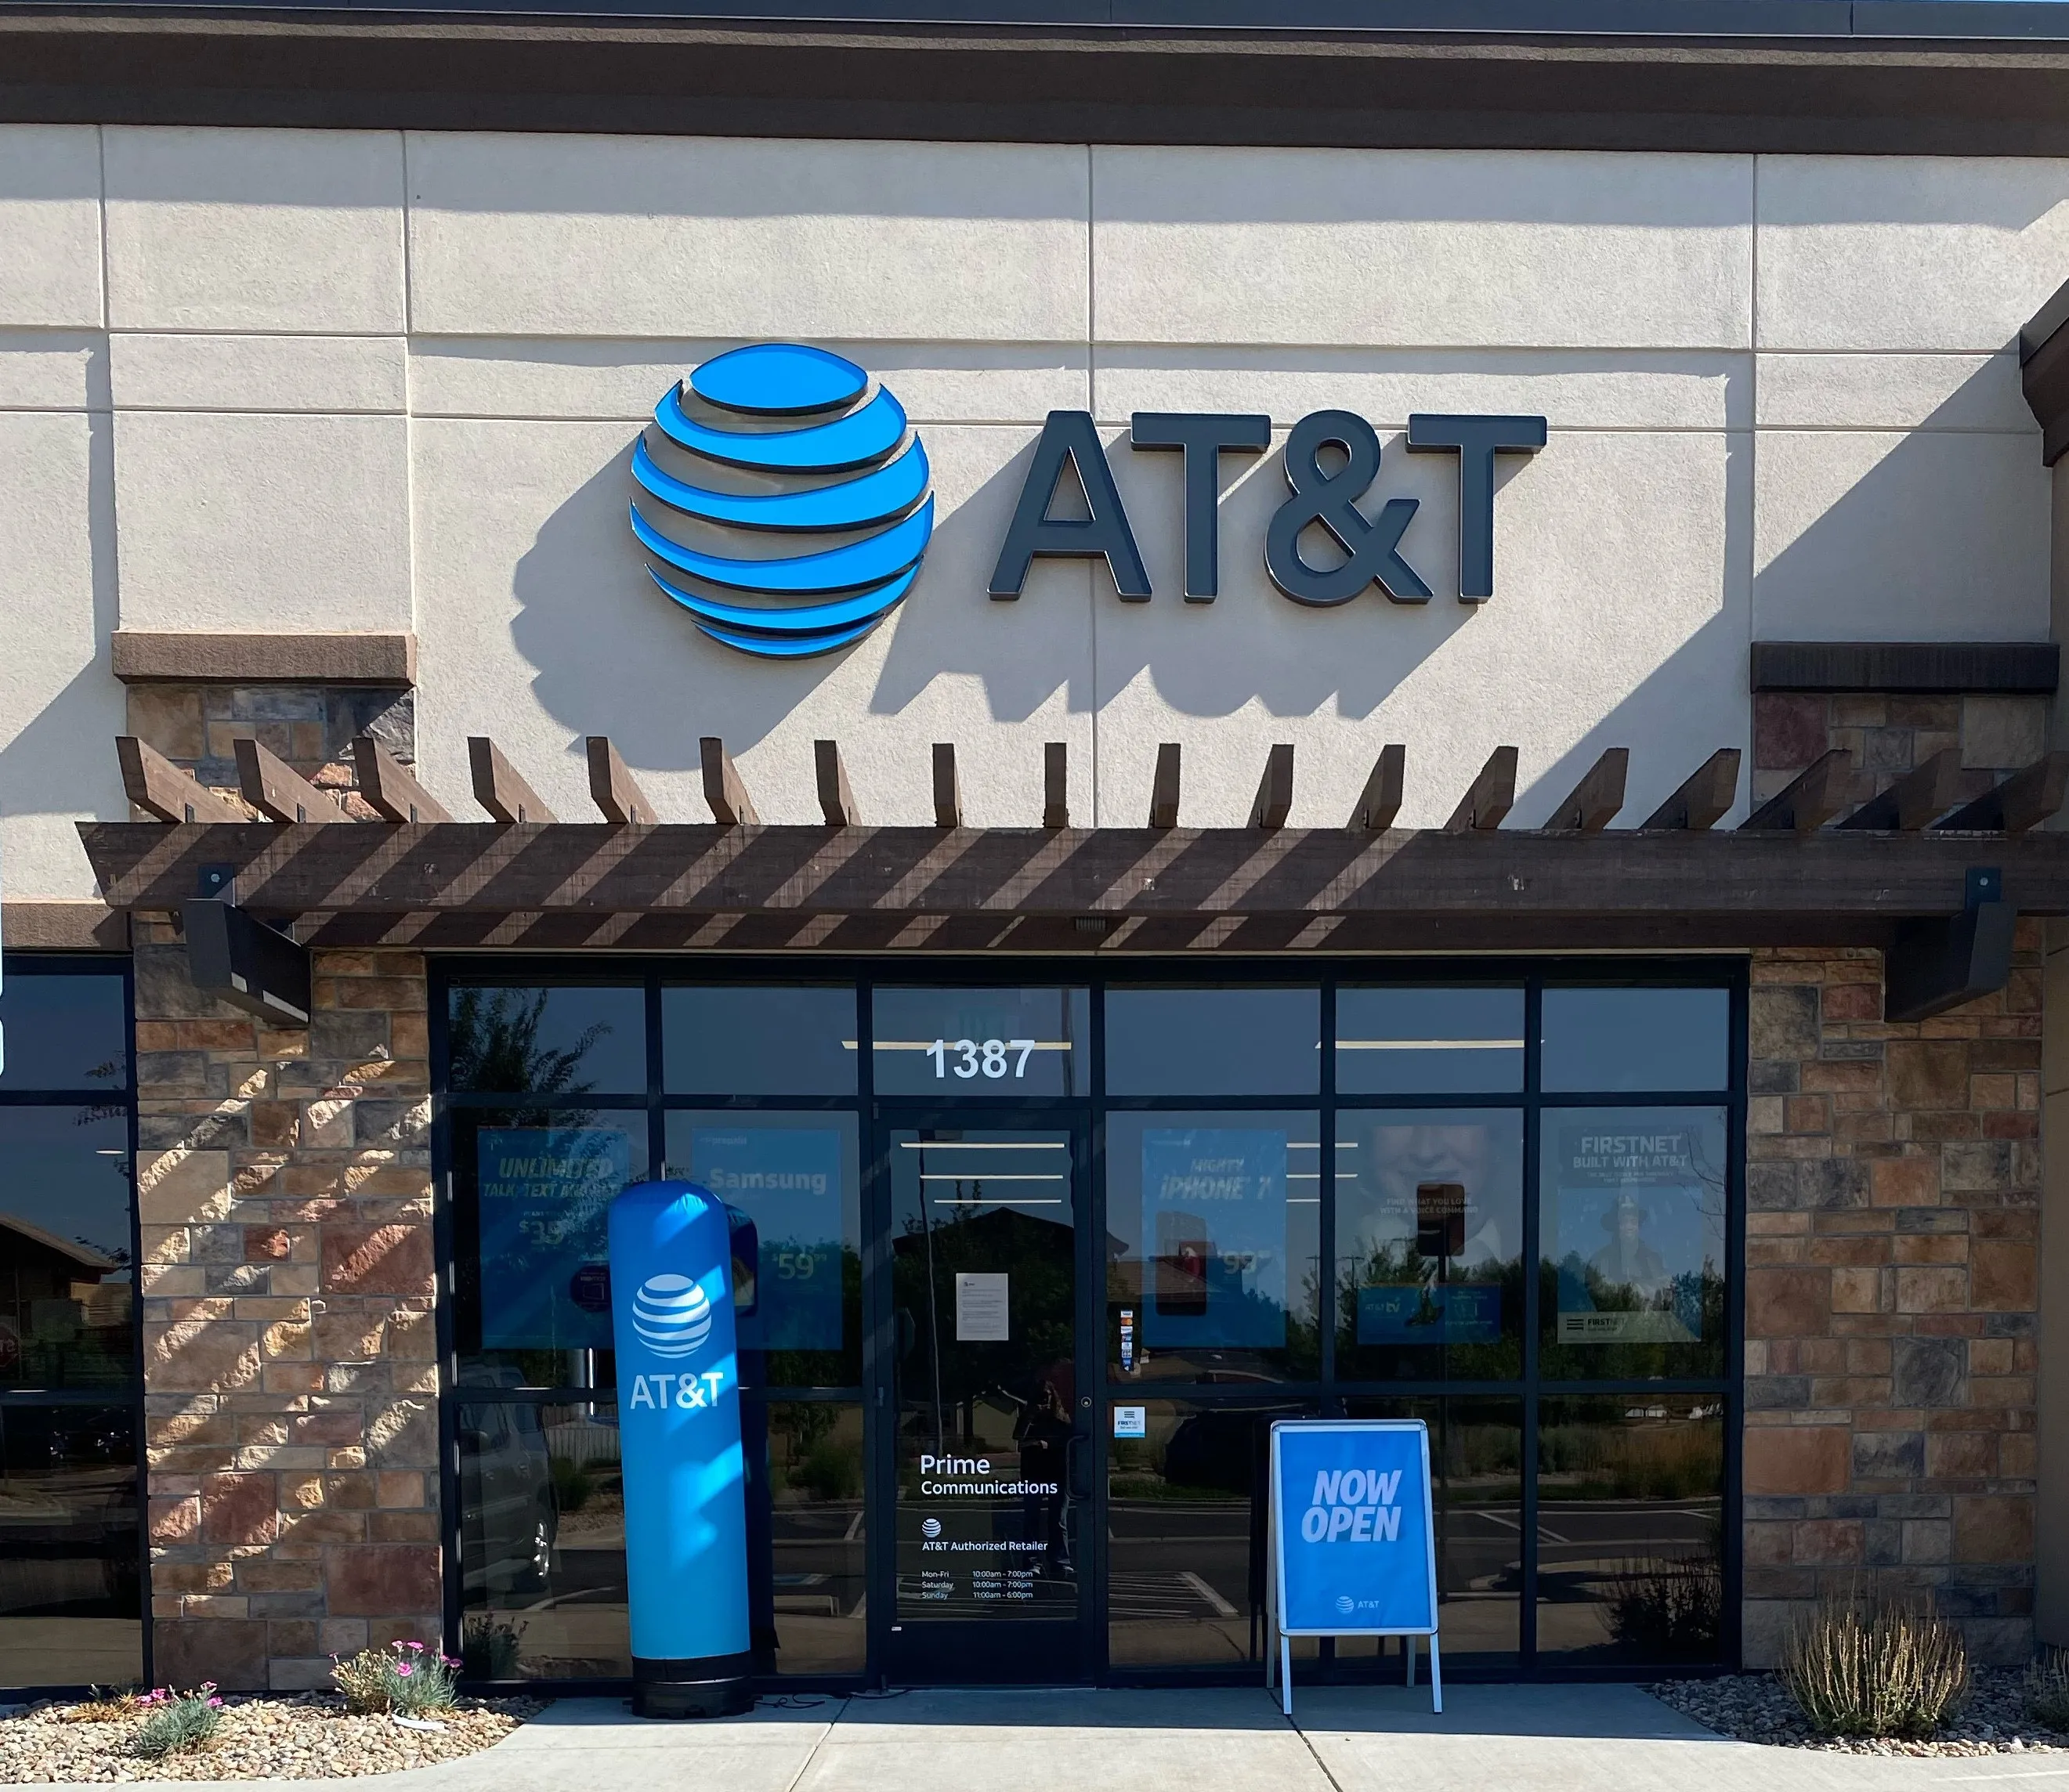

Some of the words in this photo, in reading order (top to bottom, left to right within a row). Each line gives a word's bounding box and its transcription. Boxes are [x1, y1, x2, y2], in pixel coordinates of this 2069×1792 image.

[986, 410, 1547, 608] AT&T
[926, 1039, 1035, 1078] 1387
[1580, 1135, 1682, 1154] FIRSTNET
[1572, 1155, 1609, 1169] BUILT
[1612, 1154, 1648, 1168] WITH
[1651, 1154, 1687, 1168] AT&T
[709, 1167, 827, 1196] Samsung
[524, 1183, 558, 1198] TEXT
[630, 1372, 724, 1410] AT&T
[921, 1454, 990, 1475] Prime
[921, 1479, 1058, 1495] Communications
[1311, 1469, 1402, 1505] NOW
[1301, 1506, 1402, 1543] OPEN
[922, 1541, 949, 1551] AT&T
[950, 1541, 1007, 1551] Authorized
[1008, 1541, 1048, 1551] Retailer
[1007, 1570, 1033, 1579] 7:00pm
[921, 1581, 954, 1590] Saturday
[921, 1591, 949, 1600] Sunday
[1358, 1600, 1380, 1609] AT&T
